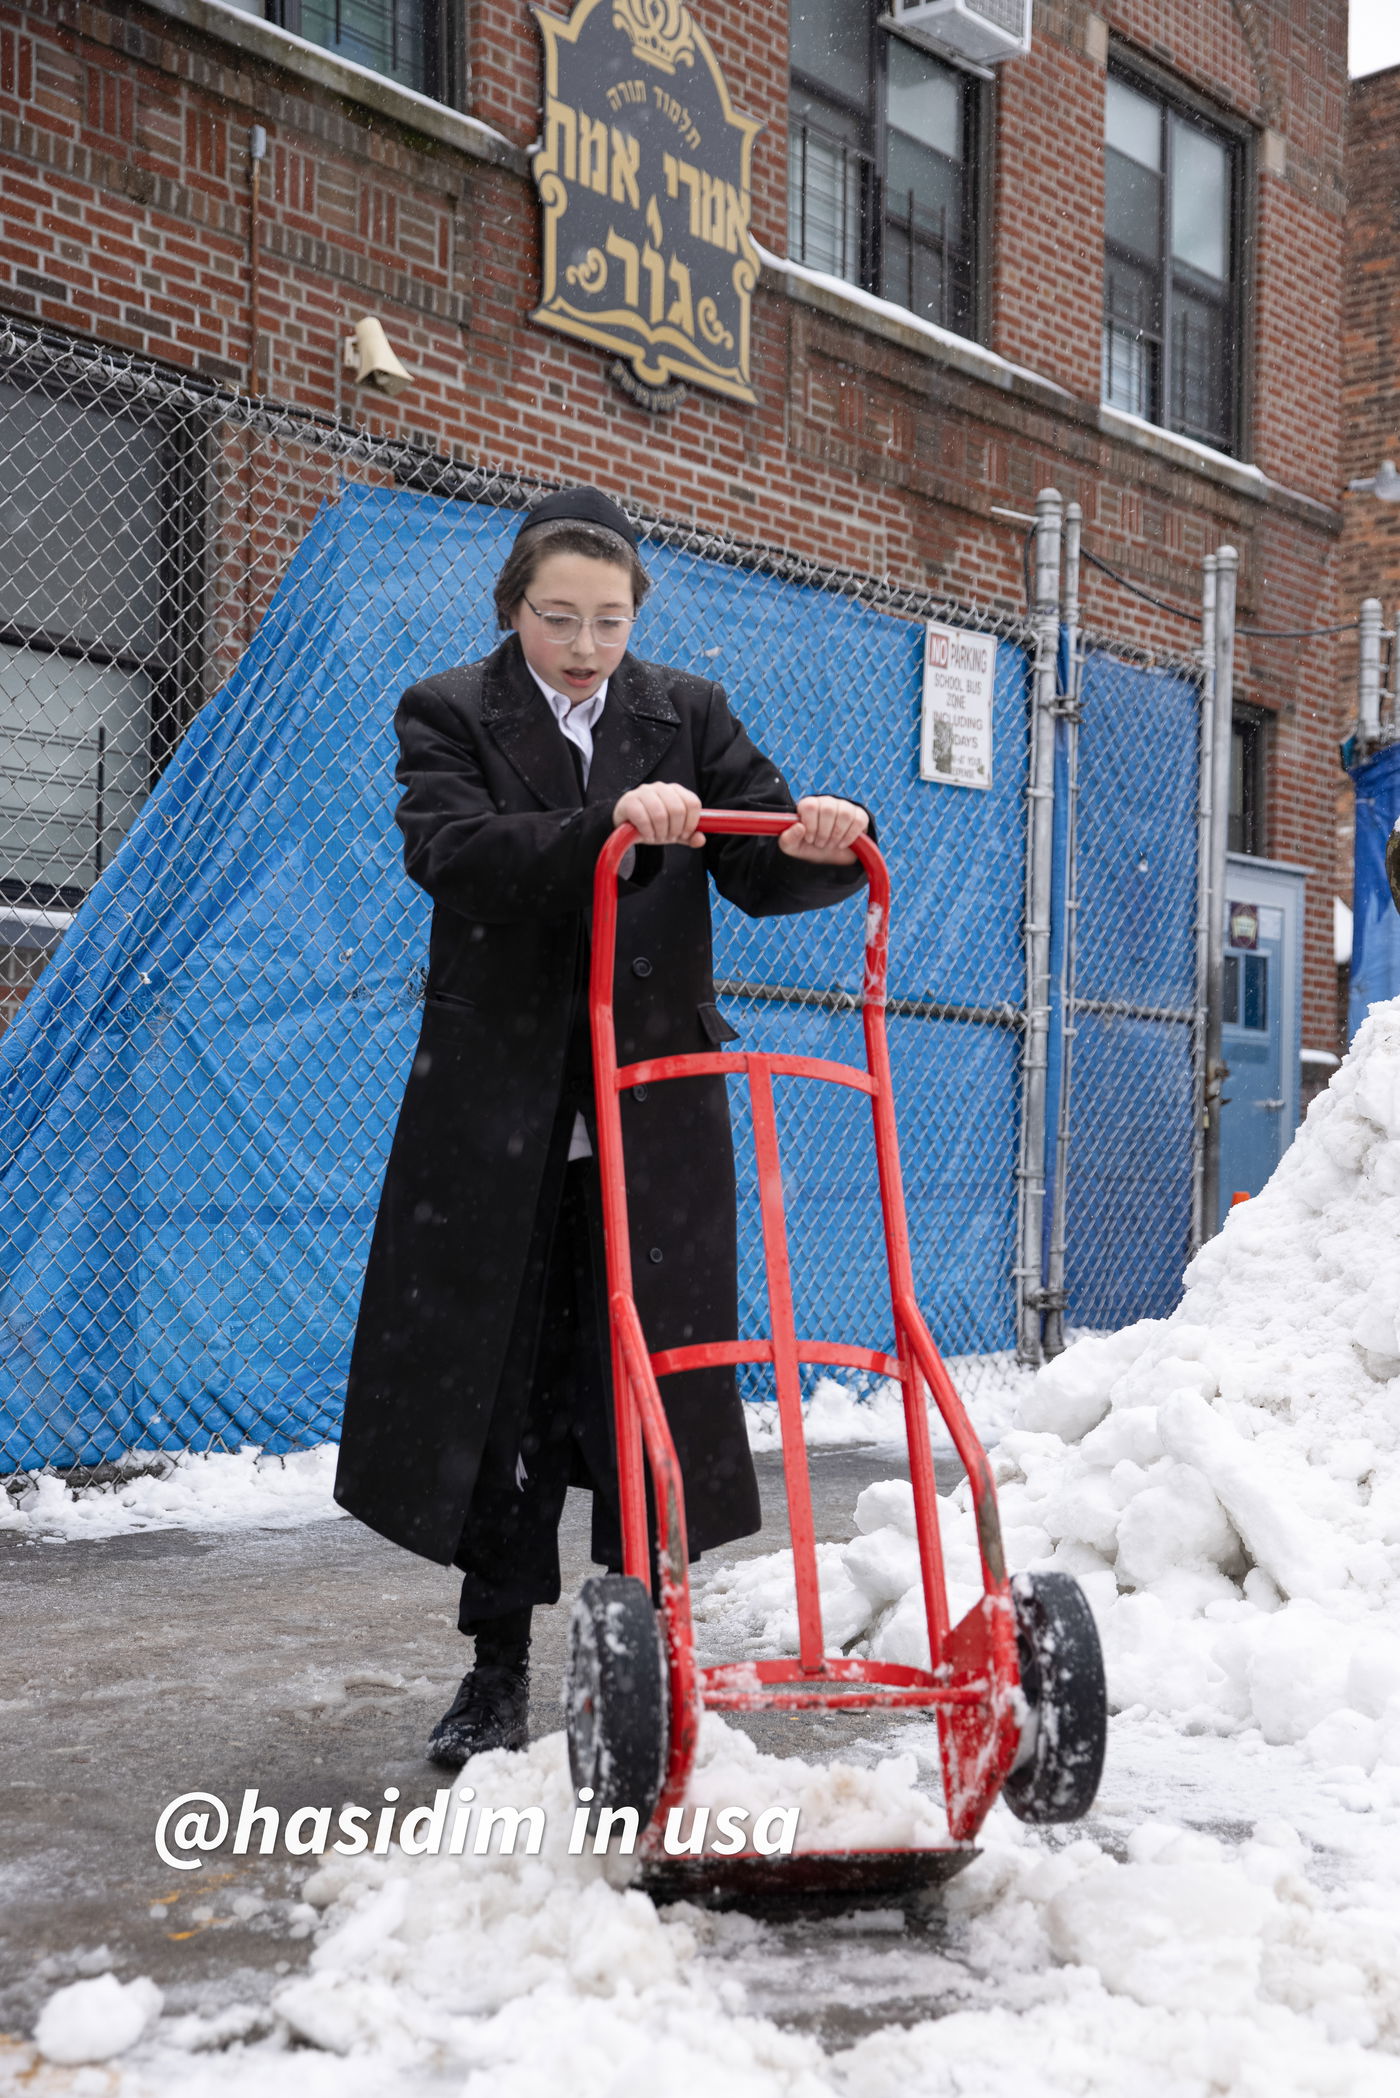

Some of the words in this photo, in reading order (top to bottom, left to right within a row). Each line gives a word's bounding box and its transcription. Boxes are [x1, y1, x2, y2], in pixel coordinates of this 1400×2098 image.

[606, 79, 647, 112] תורה
[652, 85, 702, 150] תלמוד
[544, 100, 640, 209] אמת
[663, 152, 750, 254] אמרי
[606, 226, 695, 340] גור
[931, 636, 948, 665] NO
[951, 643, 987, 674] PARKING
[934, 672, 964, 692] SCHOOL
[966, 678, 982, 696] BUS
[946, 692, 967, 710] ZONE
[933, 710, 984, 731] INCLUDING
